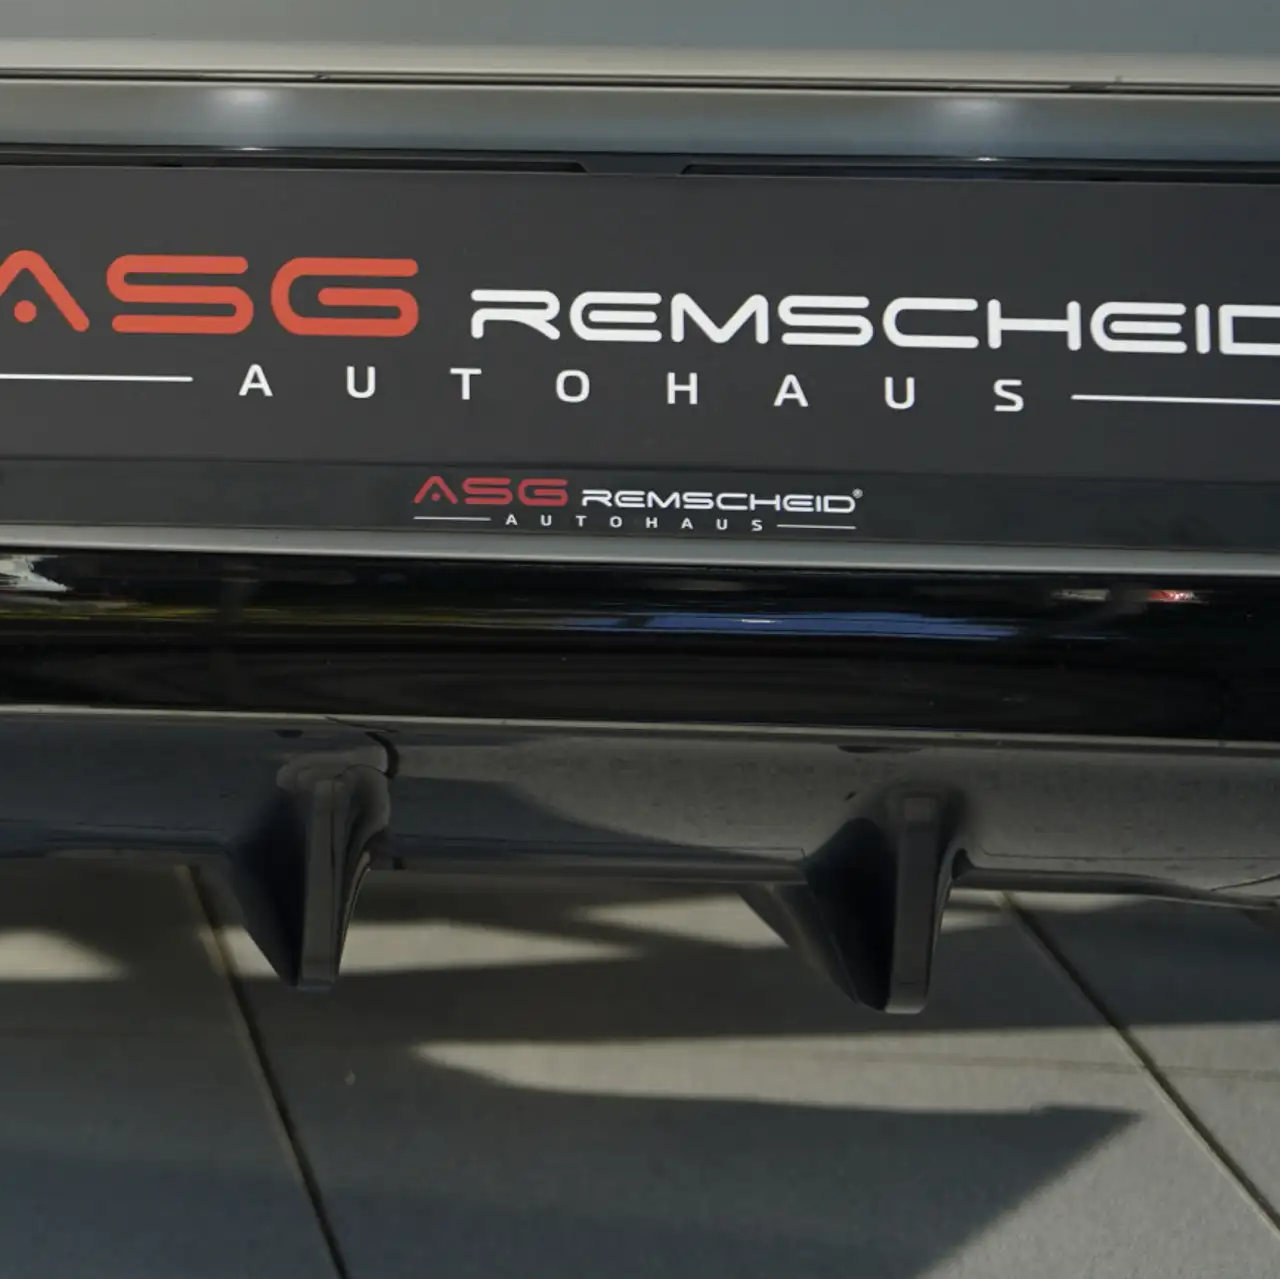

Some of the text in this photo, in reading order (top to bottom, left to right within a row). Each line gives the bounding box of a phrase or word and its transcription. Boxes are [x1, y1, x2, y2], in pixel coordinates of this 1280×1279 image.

[471, 289, 1280, 356] REMSCHEID
[238, 363, 1025, 412] AUTOHAUS
[413, 475, 569, 506] ASG
[504, 513, 764, 532] AUTOHAUS
